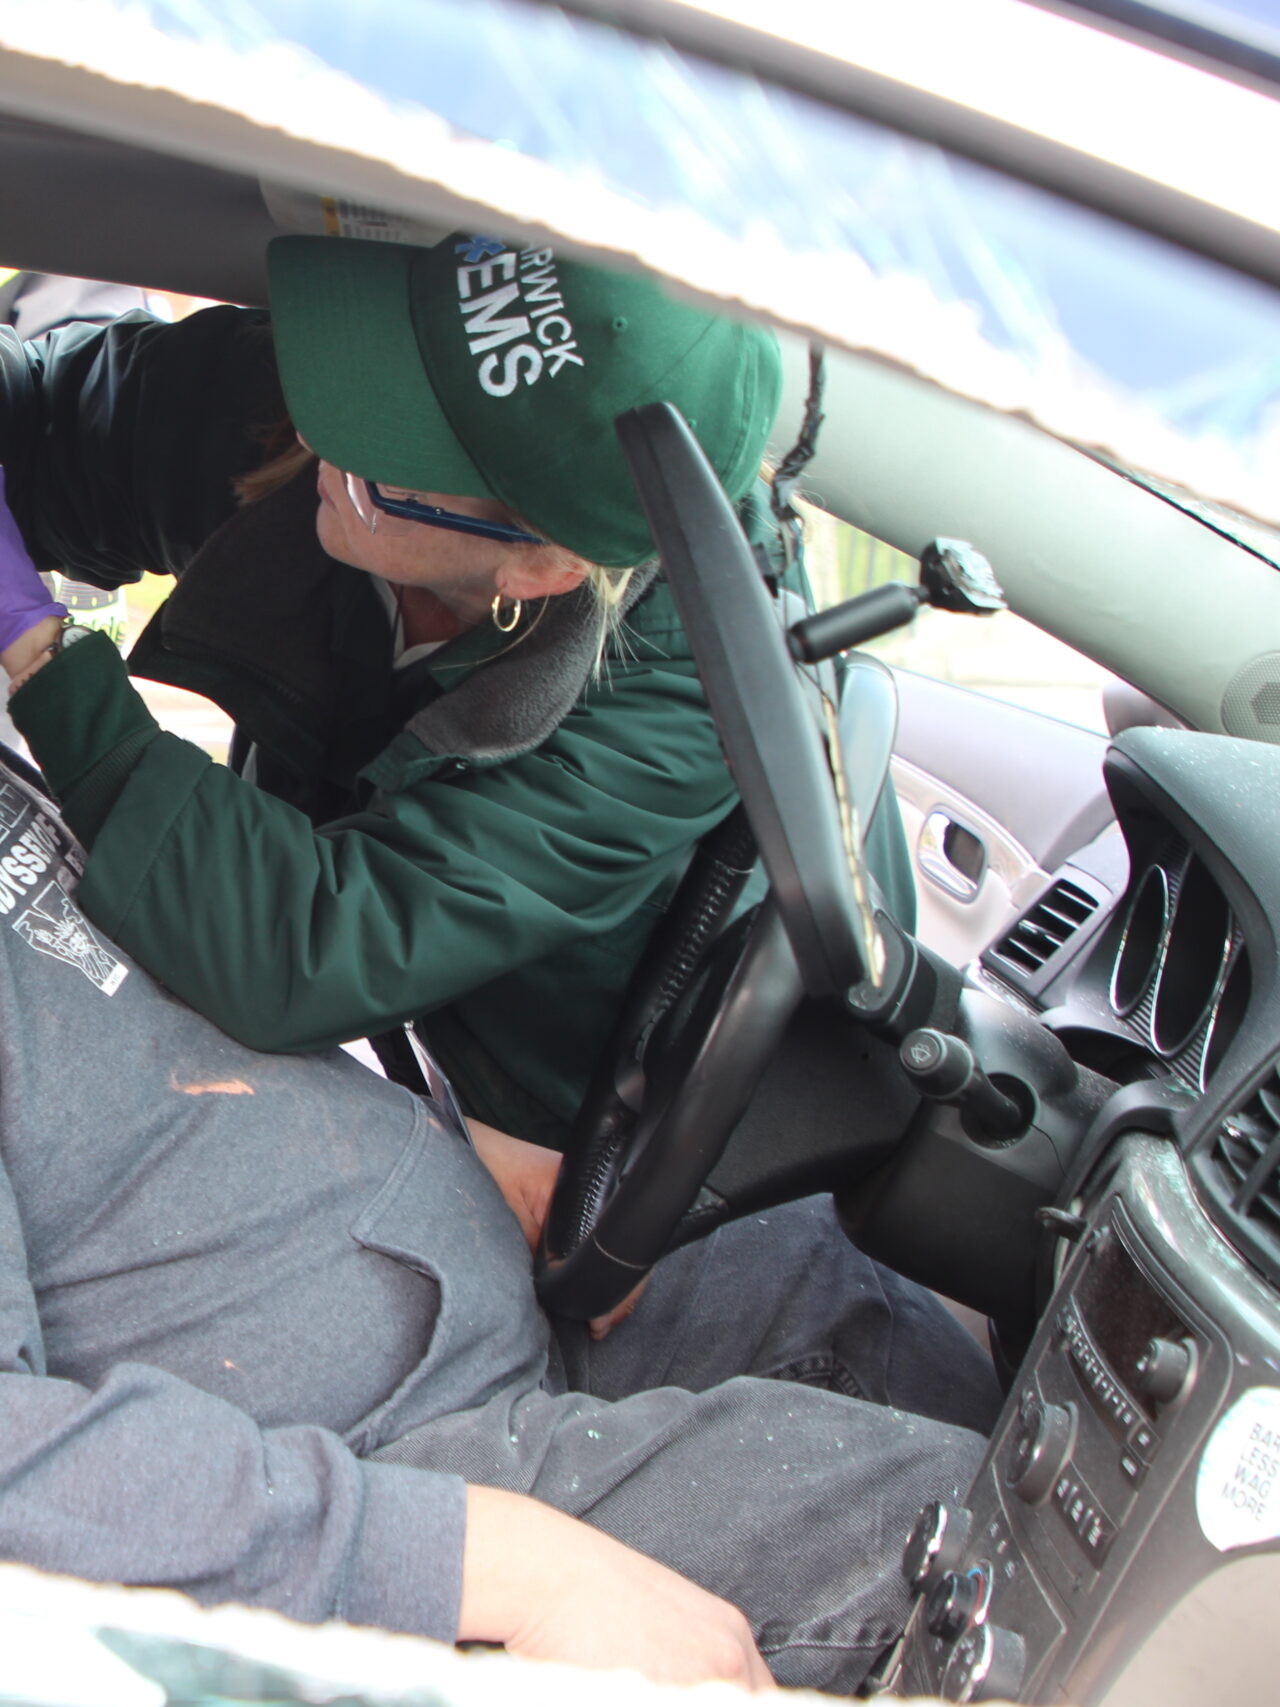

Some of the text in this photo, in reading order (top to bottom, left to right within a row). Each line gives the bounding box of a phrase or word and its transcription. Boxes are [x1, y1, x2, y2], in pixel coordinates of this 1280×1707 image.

[457, 252, 543, 398] EMS
[1240, 1440, 1280, 1479] LESS
[1221, 1481, 1267, 1522] MORE
[1234, 1463, 1271, 1500] WAG
